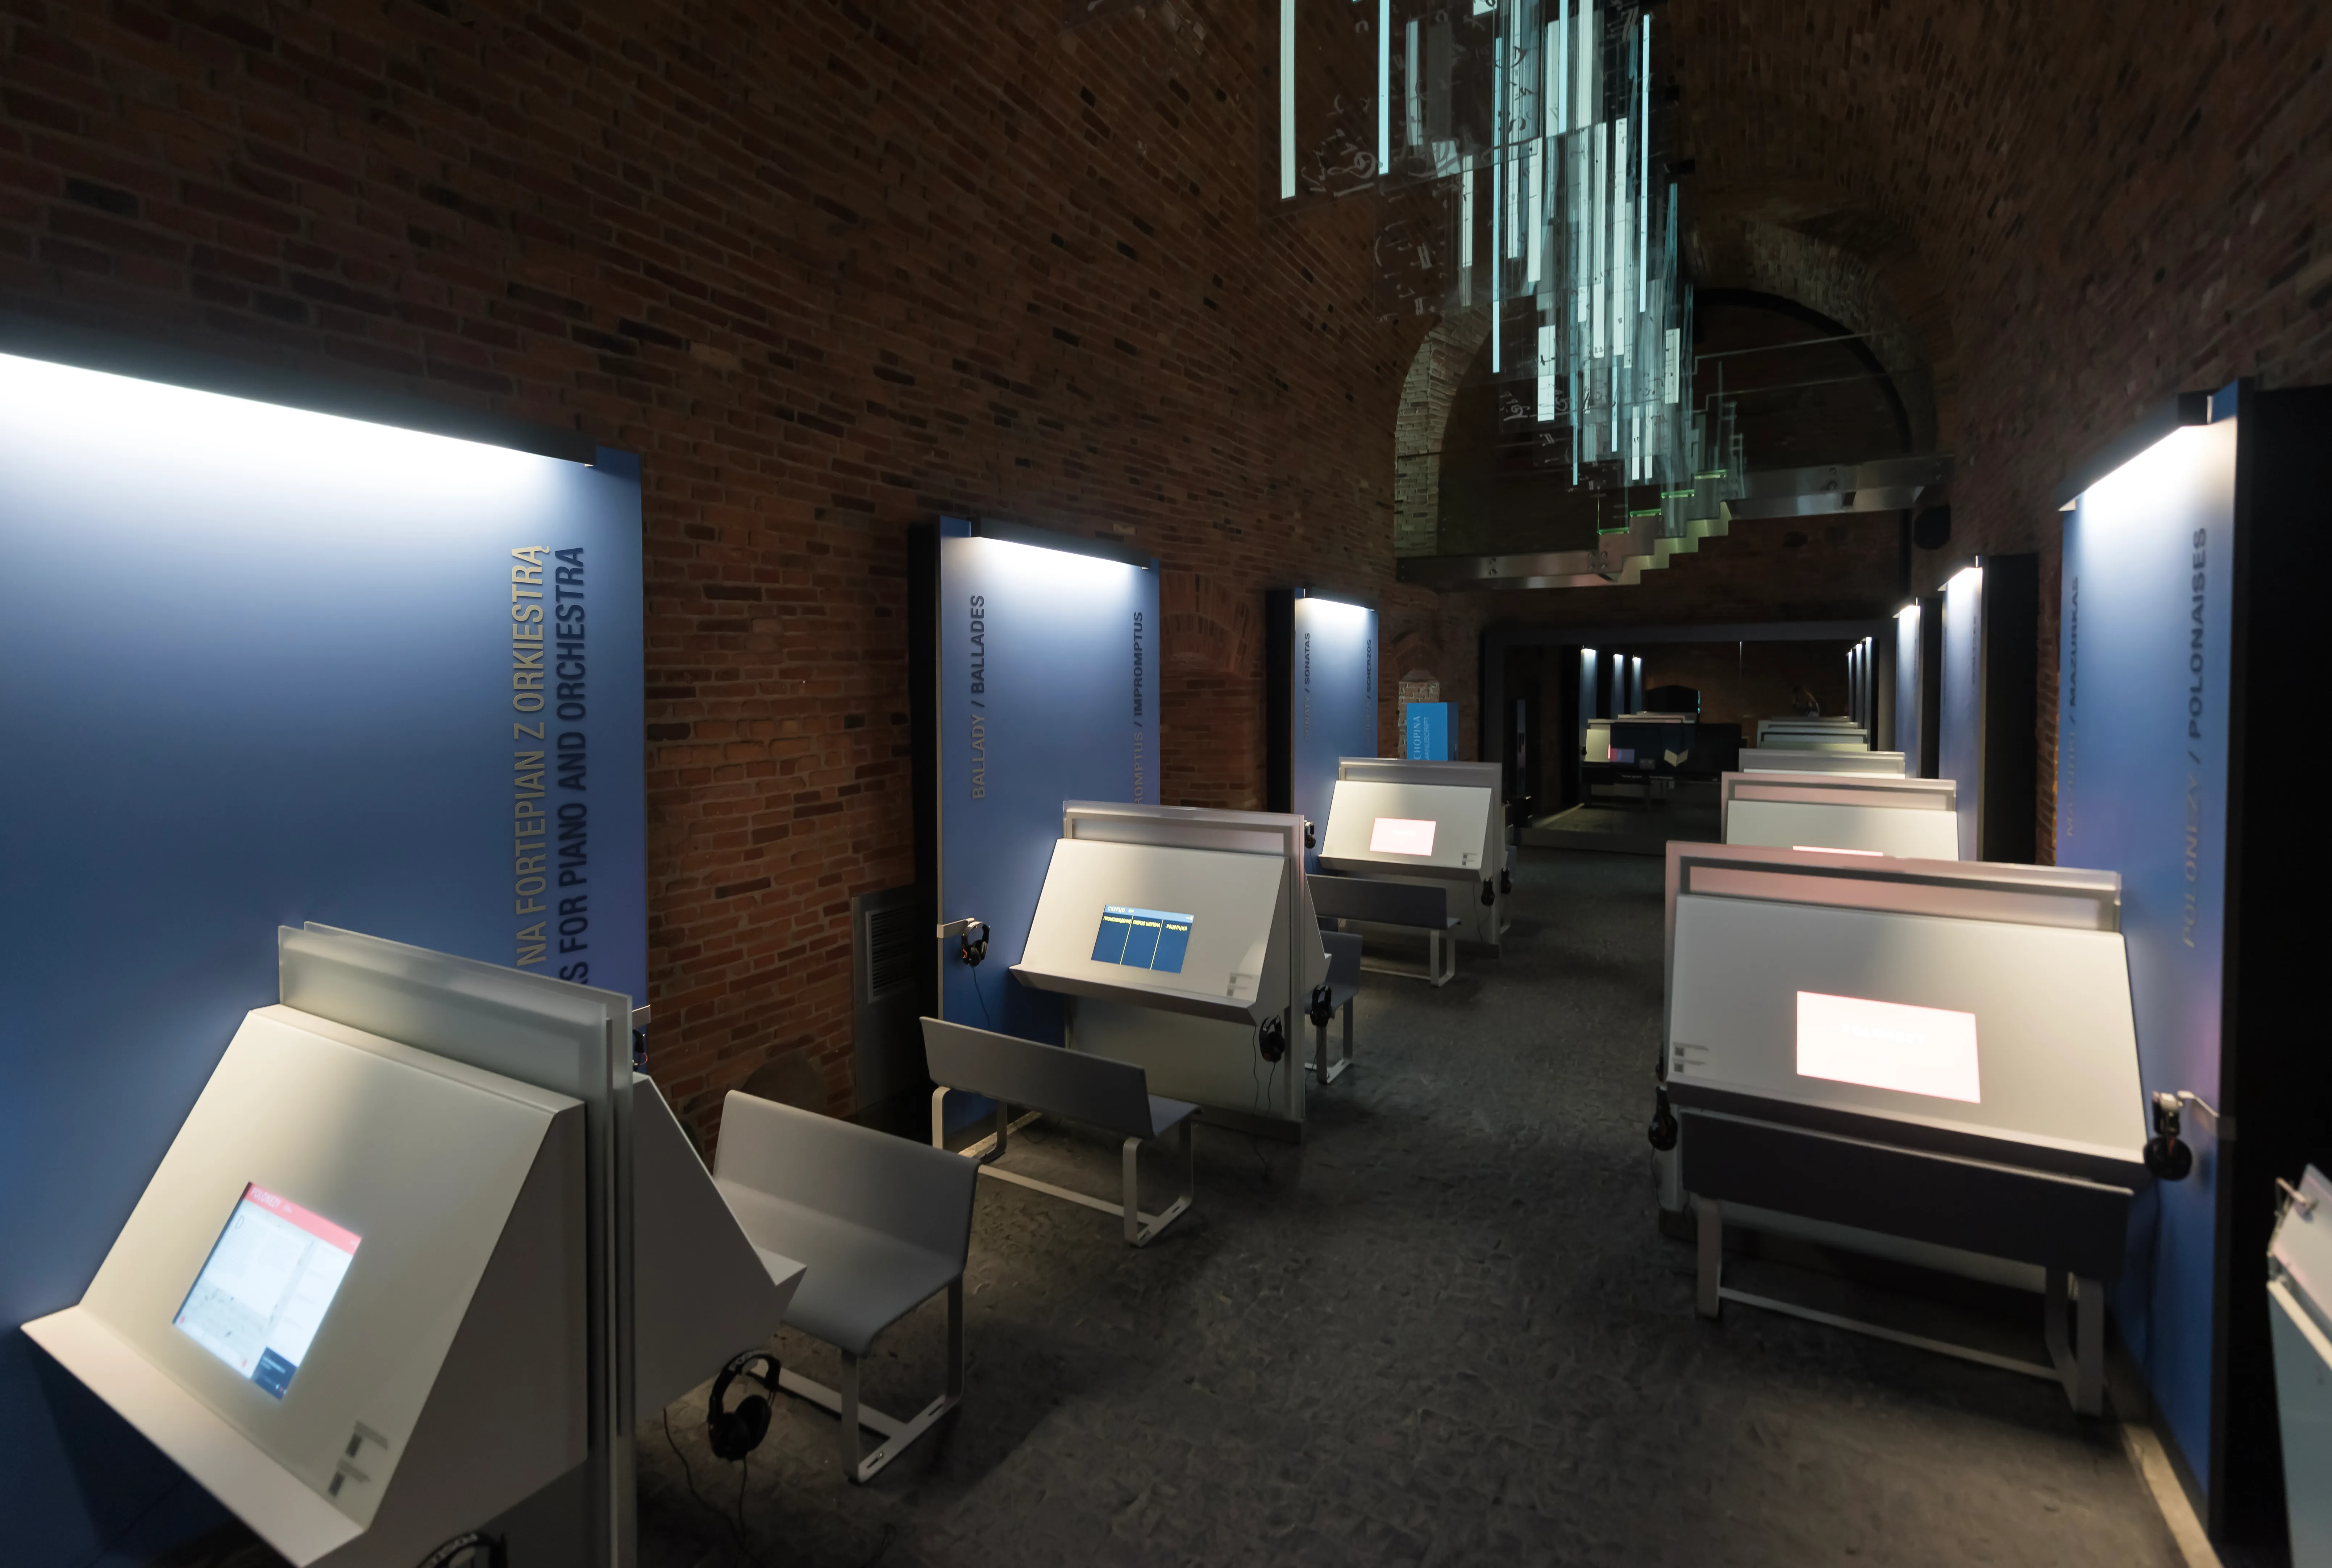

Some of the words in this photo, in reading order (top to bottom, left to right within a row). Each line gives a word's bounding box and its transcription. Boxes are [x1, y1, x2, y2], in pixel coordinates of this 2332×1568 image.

[511, 545, 550, 712] ORKIESTRĄ
[555, 547, 586, 720] ORCHESTRA
[970, 595, 985, 695] BALLADES
[1133, 612, 1143, 716] IMPROMPTUS
[2070, 577, 2078, 707] MAZURKAS
[2187, 528, 2206, 740] POLONAISES
[513, 722, 545, 739] Z
[557, 732, 586, 791] AND
[971, 713, 985, 799] BALLADY
[514, 751, 546, 915] FORTEPIAN
[557, 802, 588, 887] PIANO
[516, 921, 546, 966] NA
[558, 895, 588, 954] FOR
[559, 961, 589, 984] S
